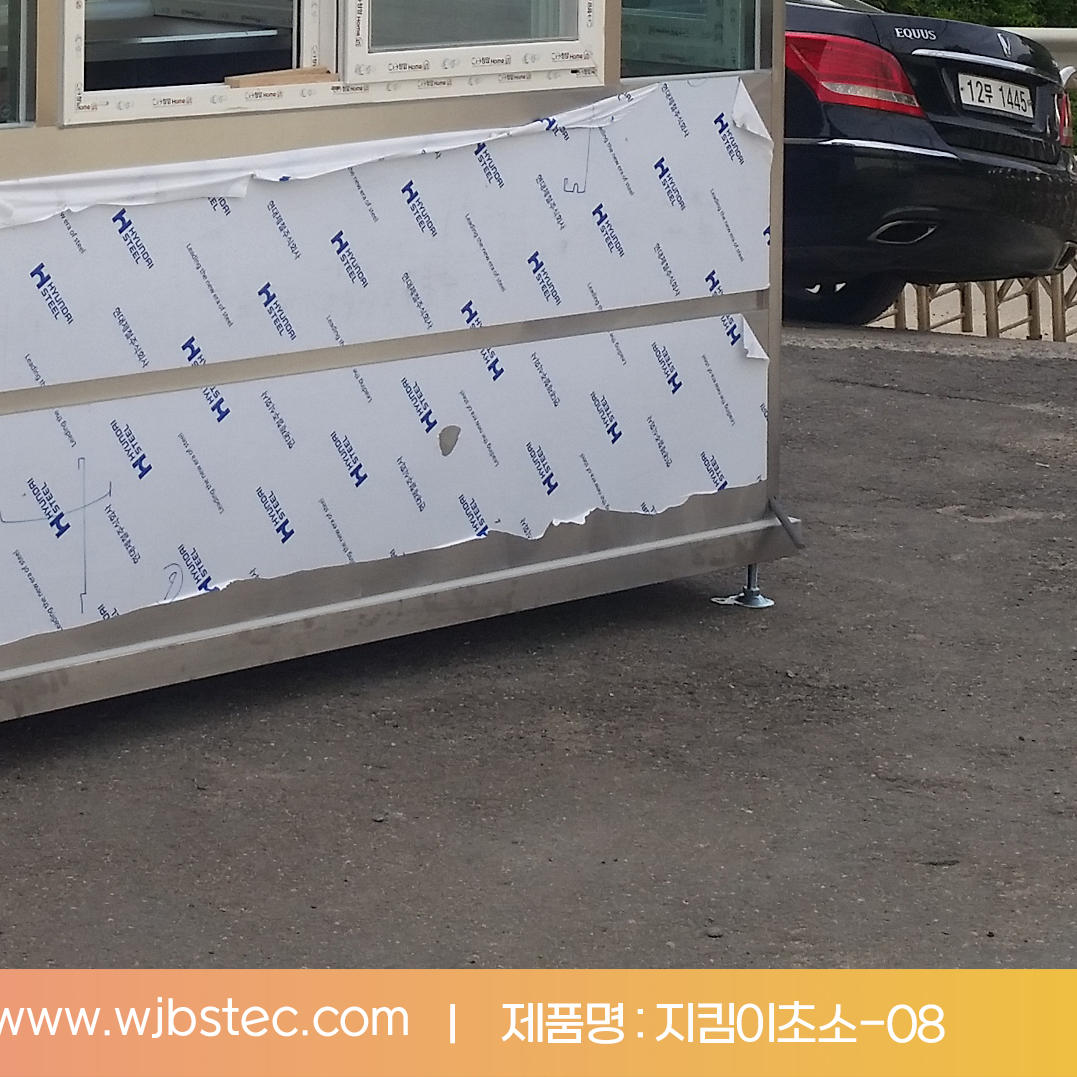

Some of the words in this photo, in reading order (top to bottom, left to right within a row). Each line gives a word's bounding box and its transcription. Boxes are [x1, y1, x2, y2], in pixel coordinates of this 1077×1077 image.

[894, 27, 937, 40] EQUUS
[967, 79, 993, 104] 12무
[999, 85, 1028, 112] 1445
[720, 135, 736, 162] STEEL
[724, 128, 745, 166] HYUNDAI
[476, 154, 495, 185] STEEL
[482, 148, 505, 188] HYUNDAI
[660, 179, 677, 208] STEEL
[666, 172, 687, 212] HYUNDAI
[408, 204, 427, 234] STEEL
[414, 196, 438, 238] HYUNDAI
[122, 232, 141, 266] STEEL
[128, 226, 155, 270] HYUNDAI
[598, 225, 615, 254] STEEL
[603, 218, 626, 258] HYUNDAI
[338, 254, 357, 284] STEEL
[344, 248, 369, 289] HYUNDAI
[538, 266, 562, 306] HYUNDAI
[40, 288, 62, 320] STEEL
[46, 281, 74, 325] HYUNDAI
[534, 272, 552, 302] STEEL
[266, 306, 286, 337] STEEL
[272, 300, 297, 341] HYUNDAI
[650, 342, 672, 380] HYUNDAI
[661, 346, 678, 374] STEEL
[400, 376, 423, 417] HYUNDAI
[412, 380, 430, 412] STEEL
[590, 390, 611, 430] HYUNDAI
[600, 394, 616, 424] STEEL
[110, 419, 136, 463] HYUNDAI
[123, 423, 145, 457] STEEL
[330, 430, 354, 472] HYUNDAI
[342, 434, 362, 466] STEEL
[525, 441, 548, 480] HYUNDAI
[536, 445, 553, 474] STEEL
[700, 451, 720, 489] HYUNDAI
[710, 454, 727, 484] STEEL
[26, 477, 54, 522] HYUNDAI
[40, 480, 64, 516] STEEL
[255, 486, 280, 527] HYUNDAI
[267, 490, 287, 521] STEEL
[458, 493, 481, 533] HYUNDAI
[469, 497, 489, 528] STEEL
[177, 544, 202, 585] HYUNDAI
[190, 547, 208, 579] STEEL
